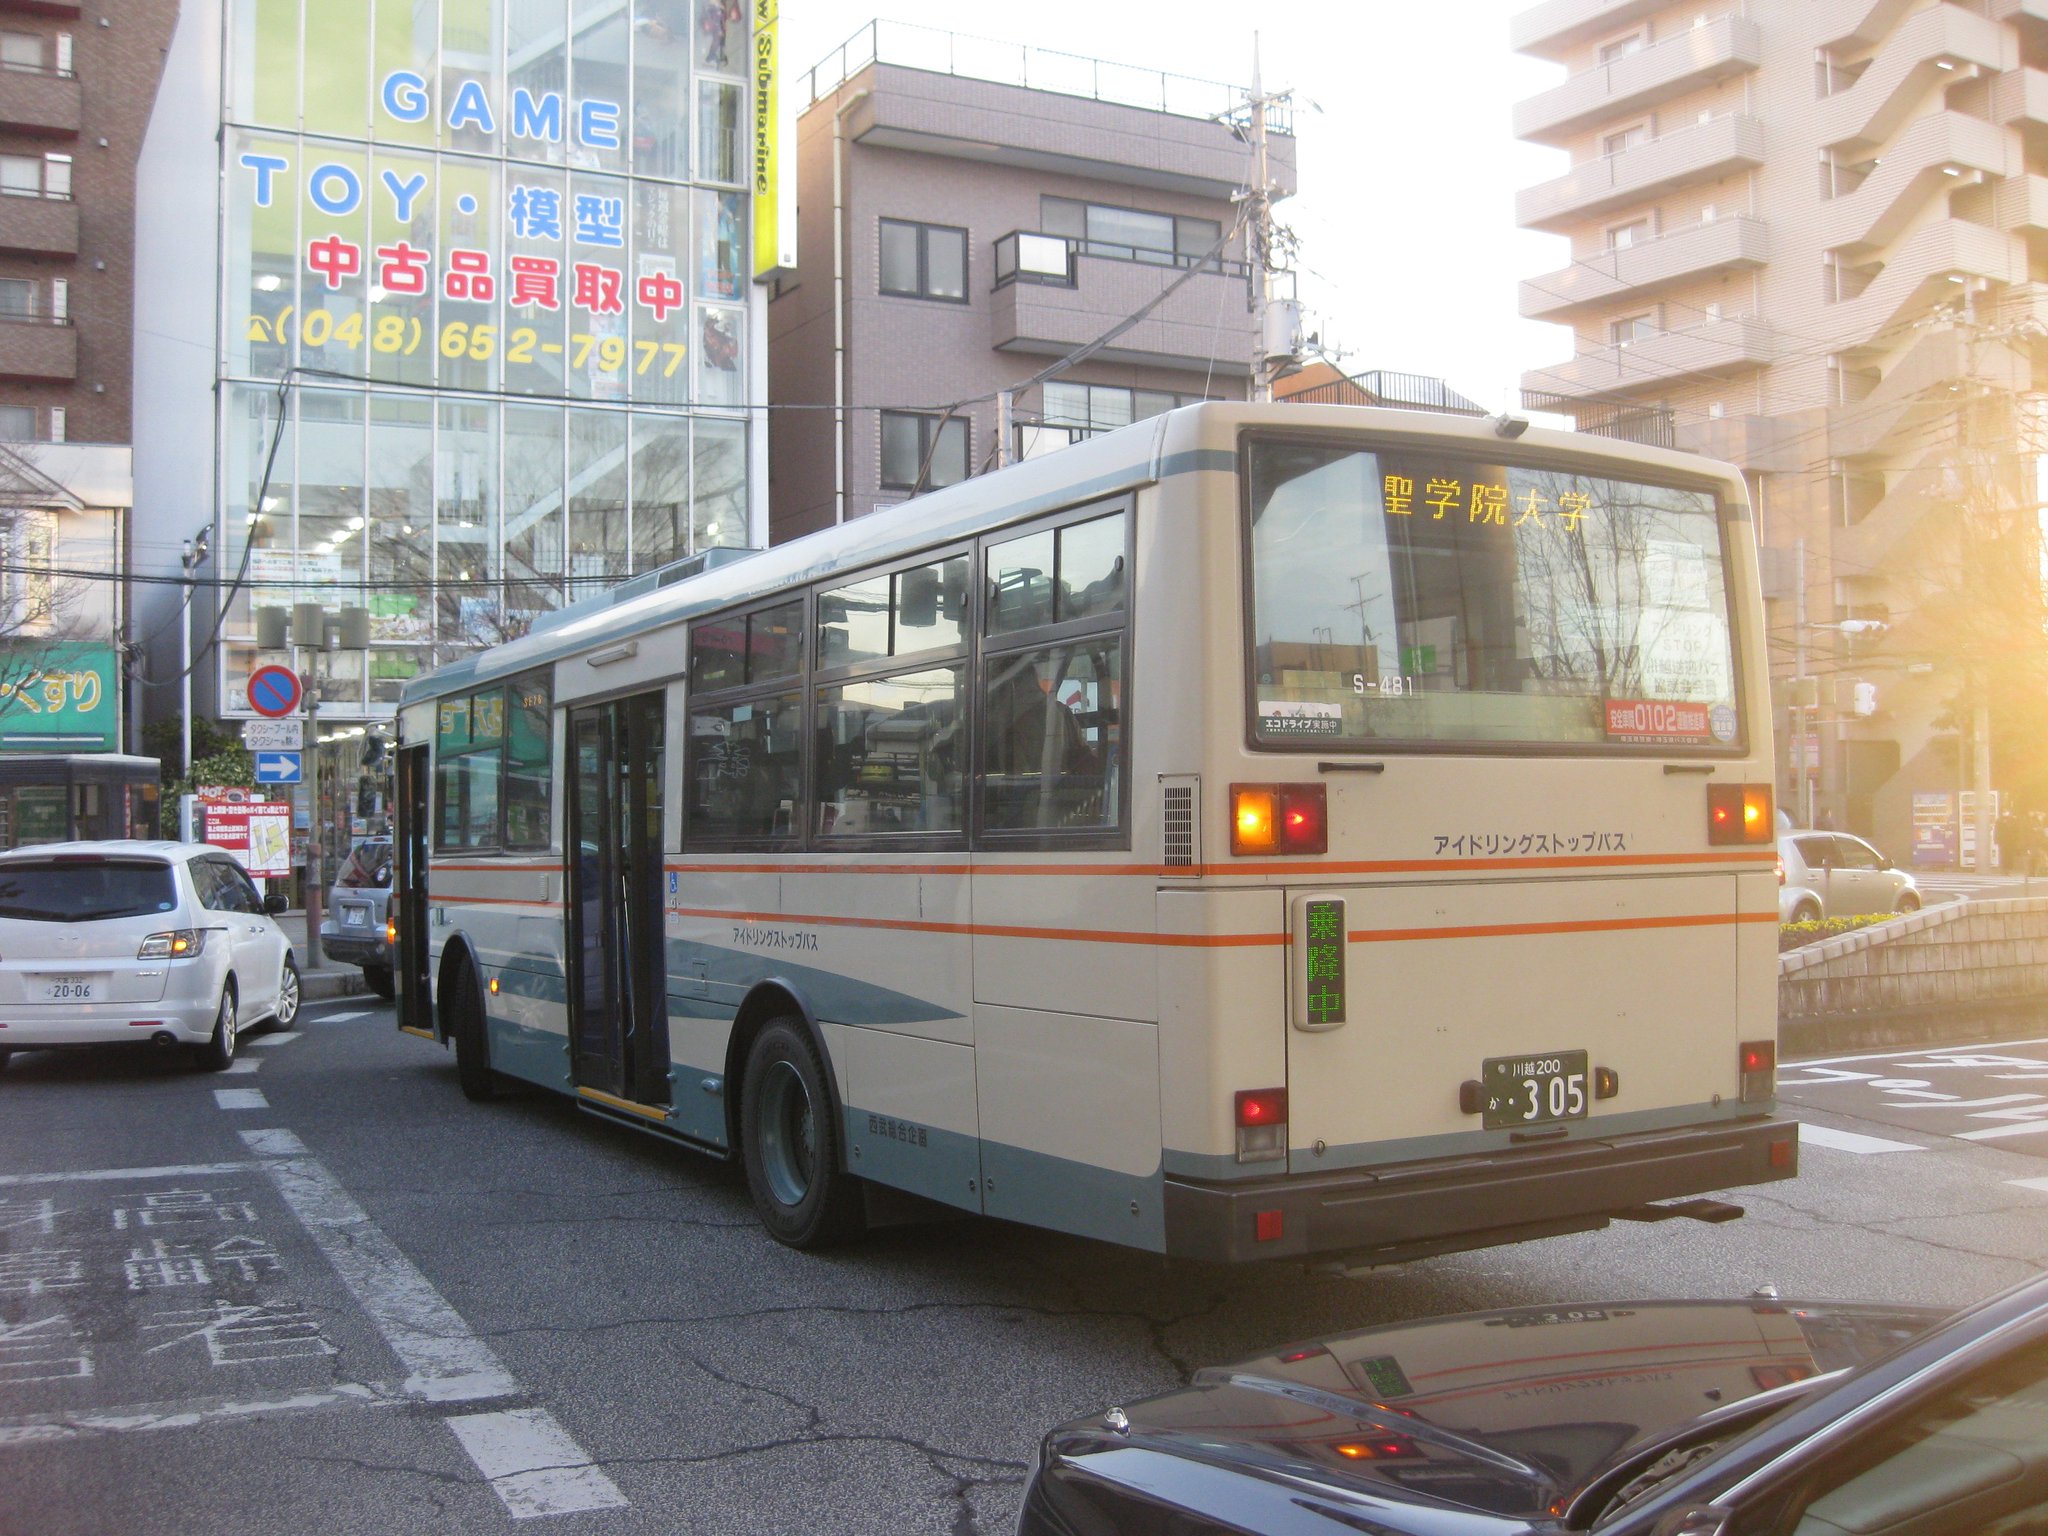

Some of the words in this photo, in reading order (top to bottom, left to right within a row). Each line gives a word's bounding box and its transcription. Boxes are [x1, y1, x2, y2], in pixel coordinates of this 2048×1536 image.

[381, 71, 620, 149] GAME
[757, 34, 772, 193] Submarine
[307, 234, 684, 321] 中古品買取中
[1384, 475, 1592, 532] 聖学院大学
[12, 668, 102, 713] くすり
[1353, 674, 1413, 697] S-481
[1265, 718, 1338, 730] エコドライブ実施中
[1433, 831, 1627, 856] アイドリングストップバス
[733, 926, 819, 951] アイドリングストップバス
[1307, 902, 1341, 1023] 乗降中
[53, 984, 91, 998] 20-06
